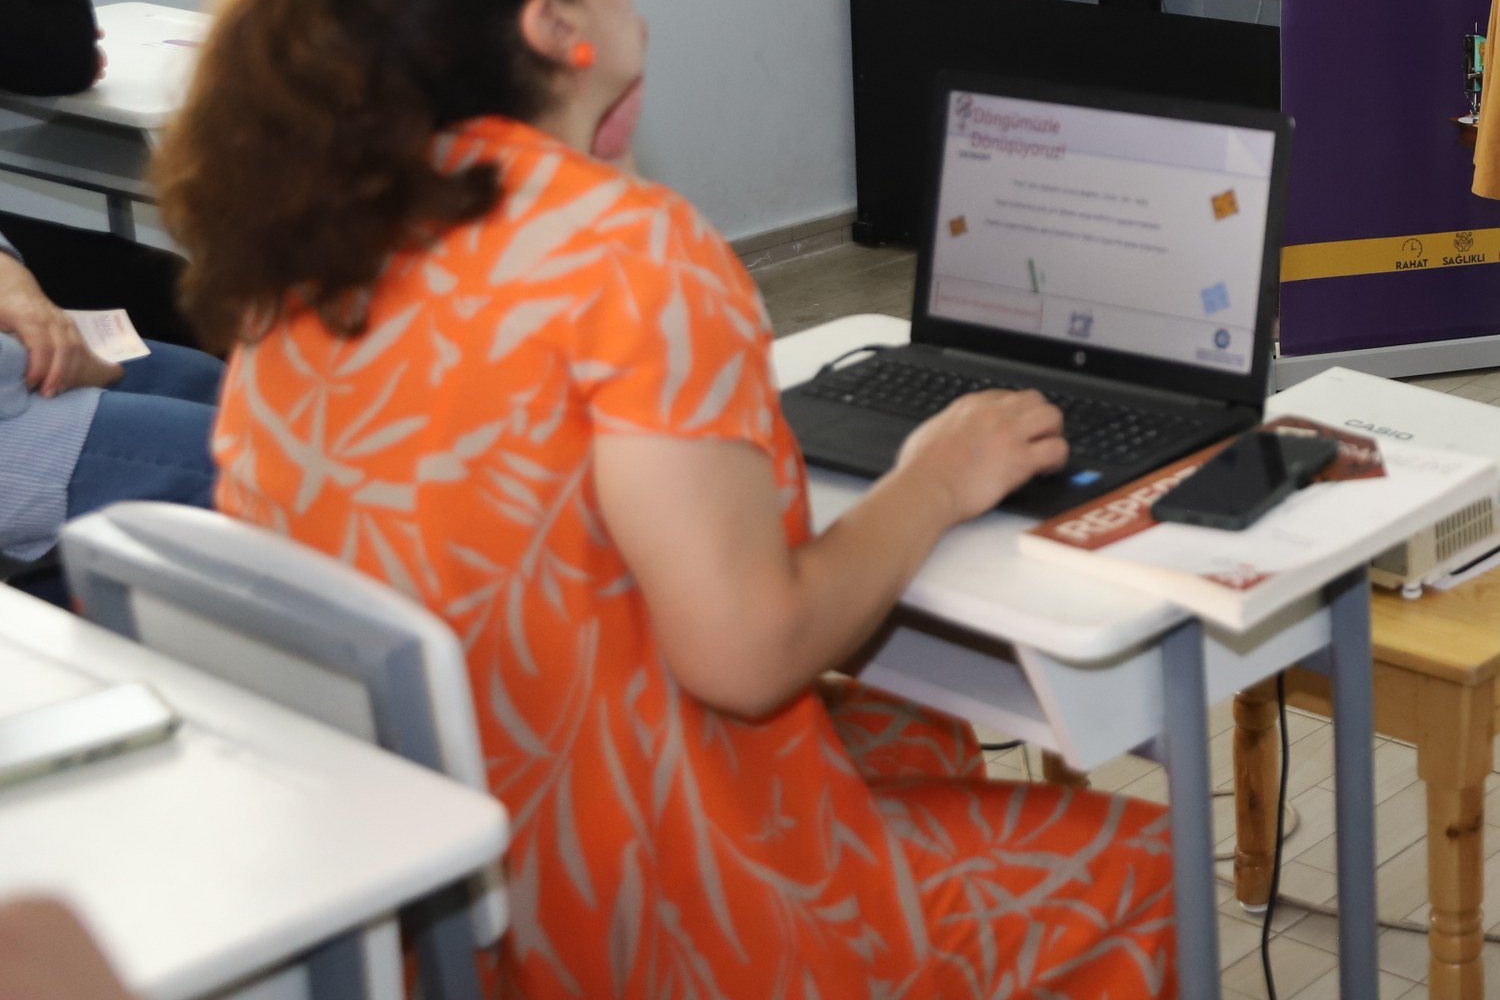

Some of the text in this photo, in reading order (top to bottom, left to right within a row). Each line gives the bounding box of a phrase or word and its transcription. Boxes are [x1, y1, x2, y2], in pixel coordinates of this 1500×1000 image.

[1395, 258, 1429, 270] RAHAT
[1442, 253, 1486, 267] SAĞLIKLI
[1344, 418, 1415, 440] CASIO
